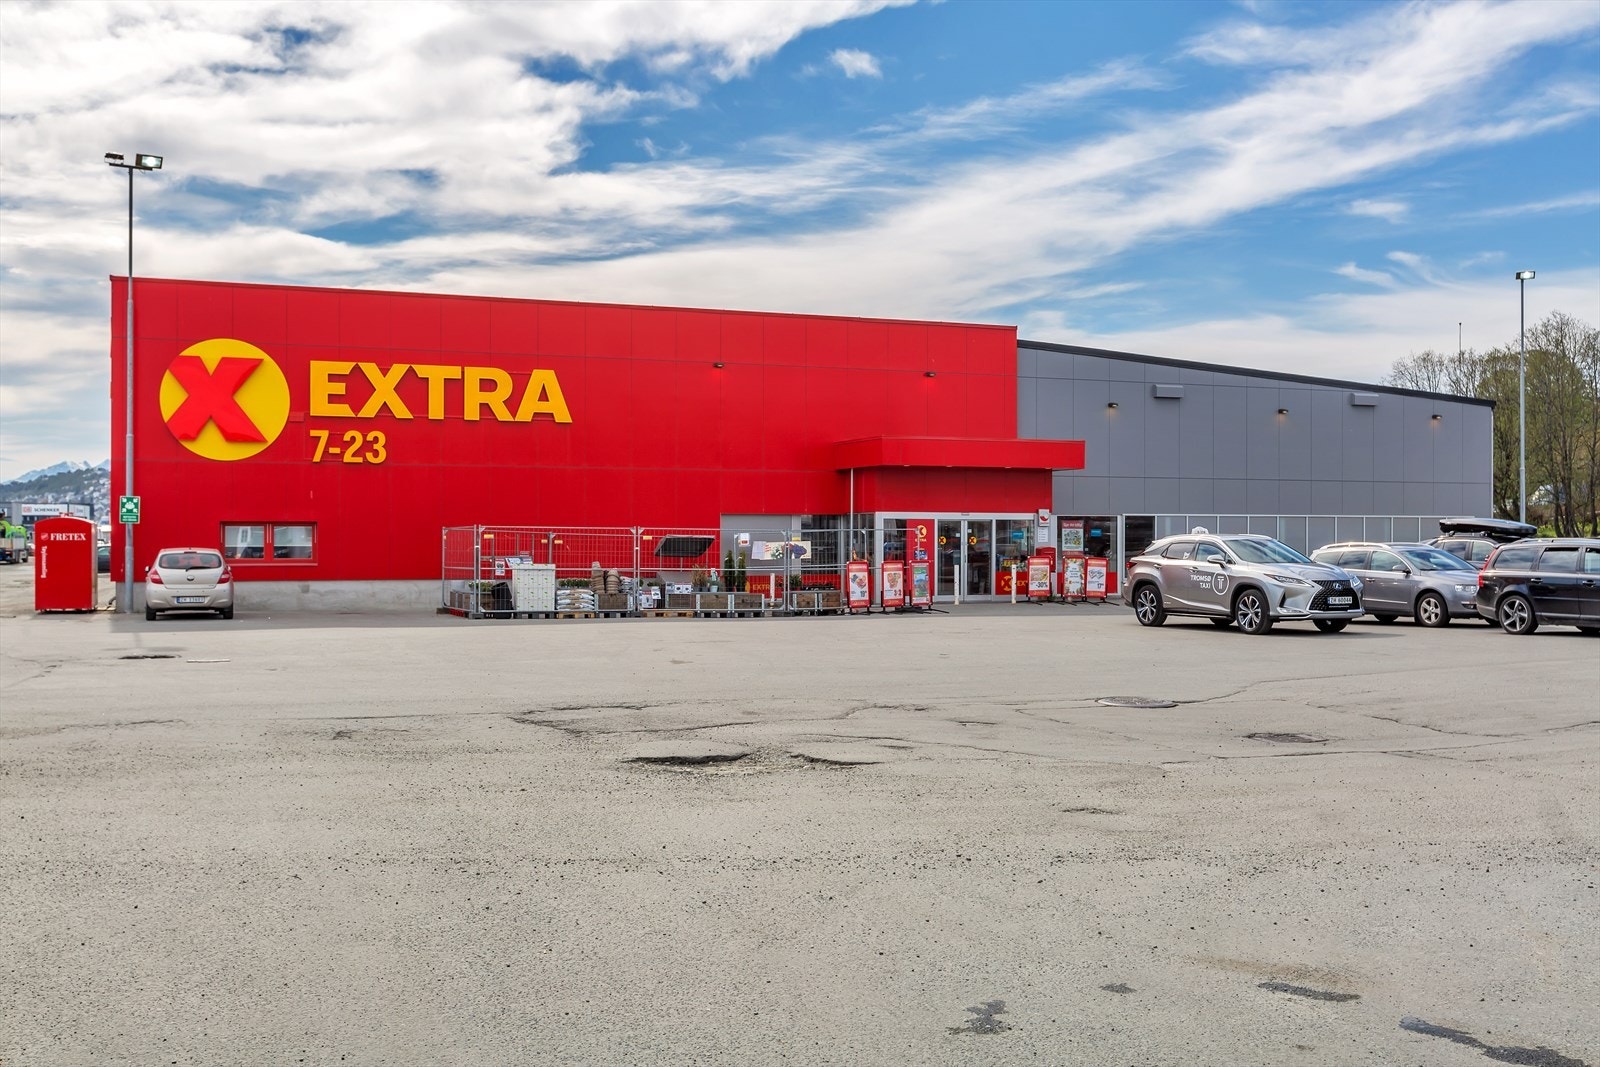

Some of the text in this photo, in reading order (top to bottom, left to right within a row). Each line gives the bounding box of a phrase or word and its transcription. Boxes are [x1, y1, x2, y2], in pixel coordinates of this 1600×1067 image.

[309, 360, 573, 424] EXTRA
[309, 430, 387, 464] 7-23
[50, 532, 87, 541] FRETEX
[1190, 574, 1212, 582] TROMSØ
